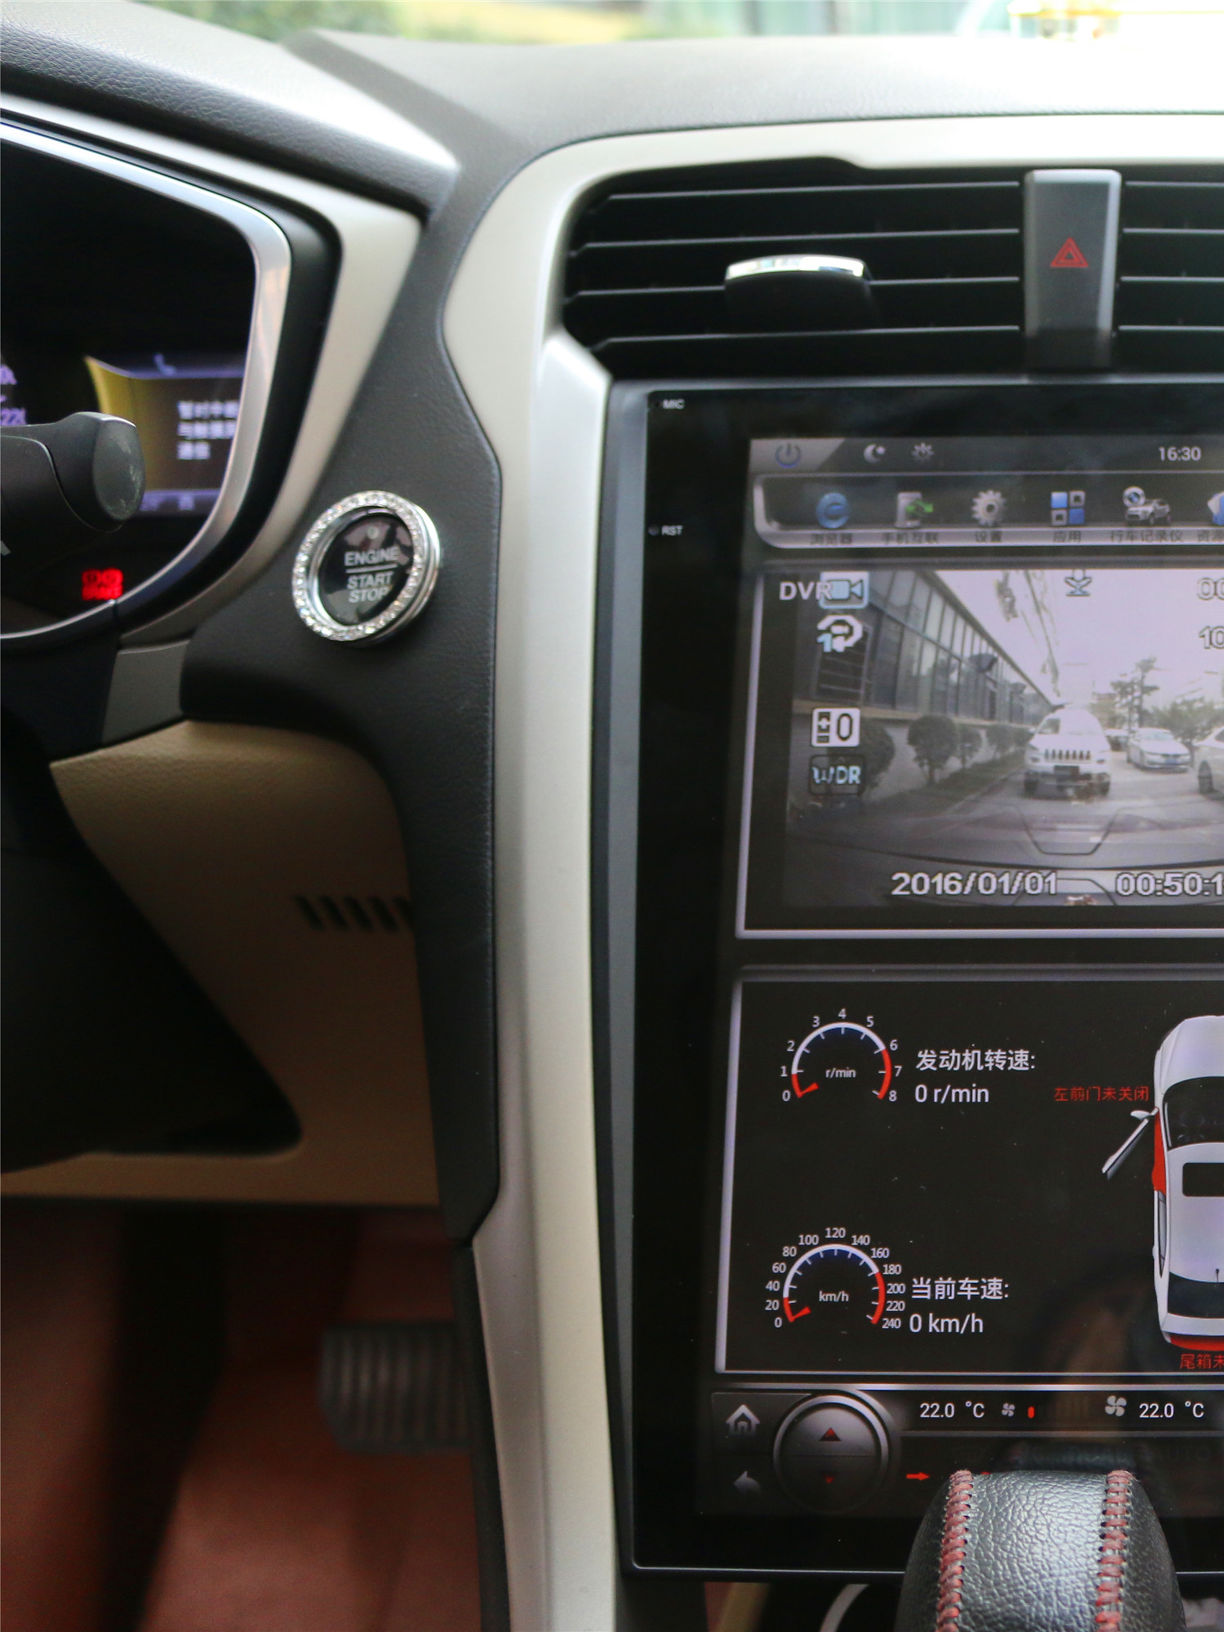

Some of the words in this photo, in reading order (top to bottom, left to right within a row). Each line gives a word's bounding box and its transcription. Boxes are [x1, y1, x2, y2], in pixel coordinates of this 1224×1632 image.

[663, 399, 684, 409] MIC
[1159, 446, 1201, 461] 16:30
[662, 525, 683, 536] RST
[1053, 530, 1082, 543] 应用
[1110, 530, 1183, 543] 行车记录仪
[344, 546, 401, 566] ENGINE
[347, 571, 394, 589] START
[349, 586, 391, 603] STOP
[779, 581, 832, 600] DVR
[812, 765, 862, 785] WDR
[891, 871, 1058, 896] 2016/01/01
[838, 1008, 847, 1019] 4
[812, 1016, 821, 1027] 3
[866, 1016, 875, 1027] 5
[787, 1040, 796, 1051] 2
[889, 1039, 898, 1051] 6
[915, 1048, 1036, 1072] 发动机转速:
[780, 1065, 788, 1077] 1
[825, 1066, 857, 1079] r/min
[894, 1066, 902, 1077] 7
[782, 1090, 791, 1102] 0
[888, 1090, 898, 1102] 8
[933, 1083, 989, 1104] r/min
[1053, 1086, 1149, 1102] 左前门未关闭
[825, 1227, 846, 1239] 120
[799, 1234, 819, 1246] 100
[851, 1234, 871, 1246] 140
[782, 1246, 797, 1258] 80
[870, 1247, 890, 1259] 160
[772, 1263, 786, 1274] 60
[882, 1264, 902, 1275] 180
[765, 1281, 780, 1292] 40
[886, 1283, 906, 1294] 200
[911, 1276, 1009, 1300] 当前车速:
[818, 1290, 849, 1303] km/h
[765, 1300, 779, 1311] 20
[886, 1301, 905, 1312] 220
[774, 1317, 783, 1329] 0
[882, 1318, 901, 1330] 240
[928, 1313, 984, 1334] km/h
[919, 1403, 955, 1418] 22.0
[1139, 1403, 1174, 1418] 22.0
